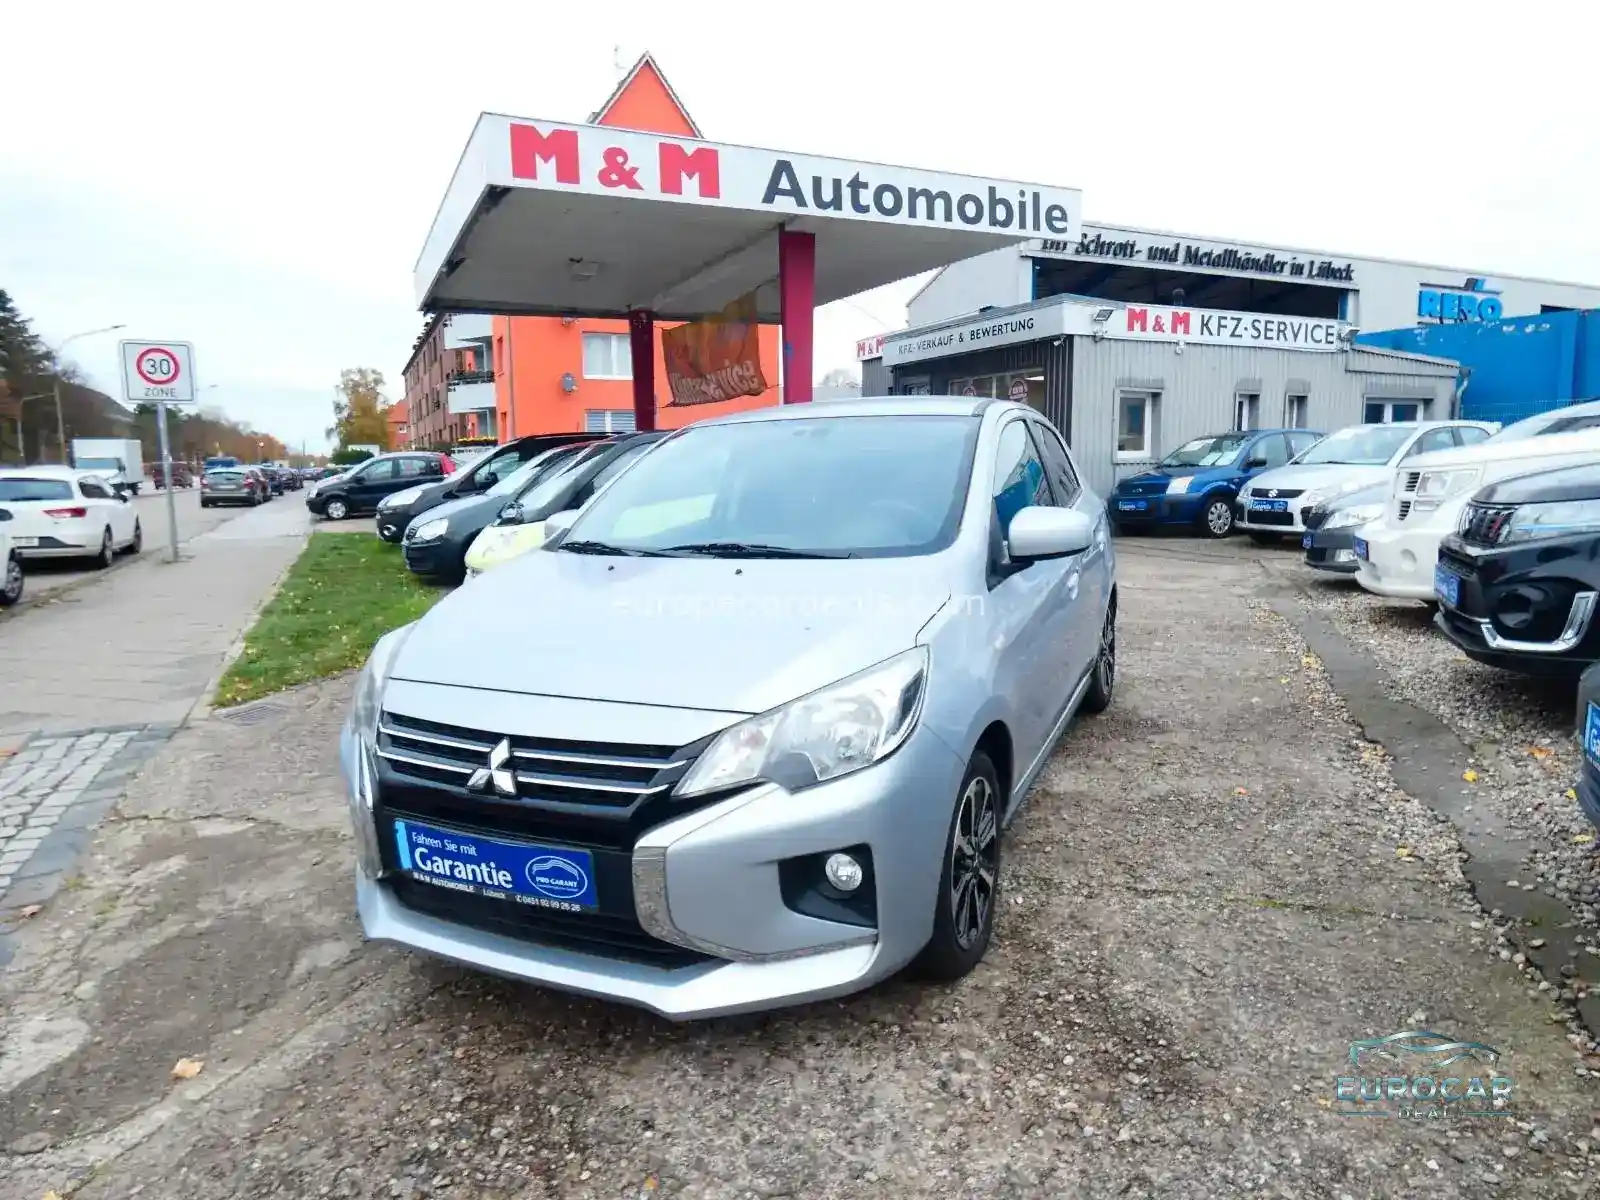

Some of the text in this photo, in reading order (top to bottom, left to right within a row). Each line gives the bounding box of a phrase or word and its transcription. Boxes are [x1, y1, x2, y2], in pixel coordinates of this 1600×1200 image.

[510, 123, 1069, 235] M & M Automobile
[1148, 242, 1180, 263] und
[1183, 245, 1288, 274] Metallhändler
[1290, 257, 1305, 276] in
[1307, 260, 1354, 281] Lübeck
[958, 332, 965, 343] &
[969, 317, 1034, 341] BEWERTUNG
[1127, 308, 1148, 332] M
[1152, 315, 1165, 333] &
[1171, 311, 1191, 335] M
[145, 358, 171, 375] 30
[144, 387, 177, 397] ZONE
[412, 831, 478, 856] Fahren Sie mit
[414, 847, 513, 889] Garantie
